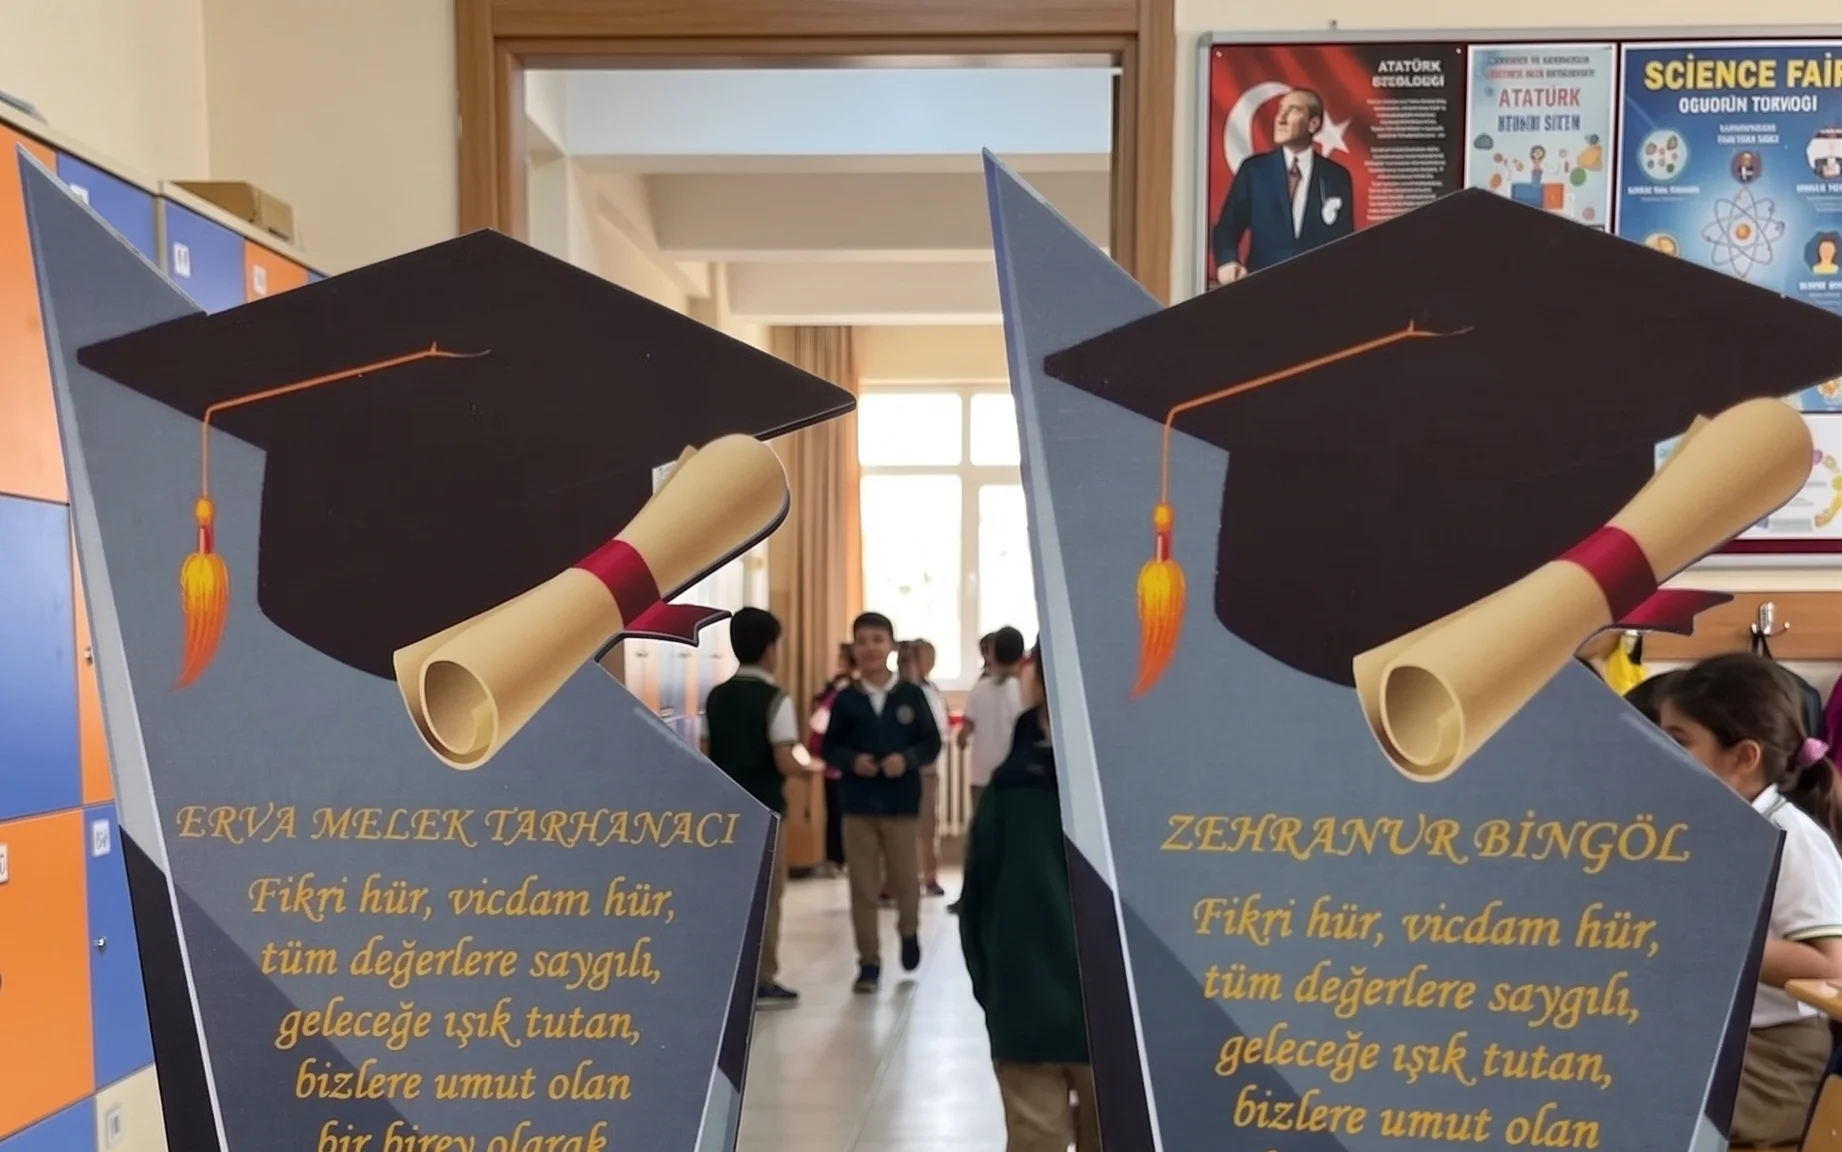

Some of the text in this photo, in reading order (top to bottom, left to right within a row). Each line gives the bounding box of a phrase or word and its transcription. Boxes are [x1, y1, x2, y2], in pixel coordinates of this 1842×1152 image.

[176, 804, 741, 849] ERVA MELEK TARHANACI
[1160, 810, 1690, 874] ZEHRANUR BİNGÖL
[249, 873, 675, 924] Fikri hür, vicdam hür,
[1193, 893, 1660, 958] Fikri hür, vicdam hür,
[261, 936, 661, 991] tüm değerlere saygılı,
[275, 996, 641, 1050] geleceğe ışık tutan,
[1203, 961, 1640, 1030] tüm değerlere saygılı,
[295, 1059, 631, 1101] bizlere umut olan
[1215, 1024, 1613, 1090] geleceğe ışık tutan,
[1233, 1085, 1600, 1149] bizlere umut olan
